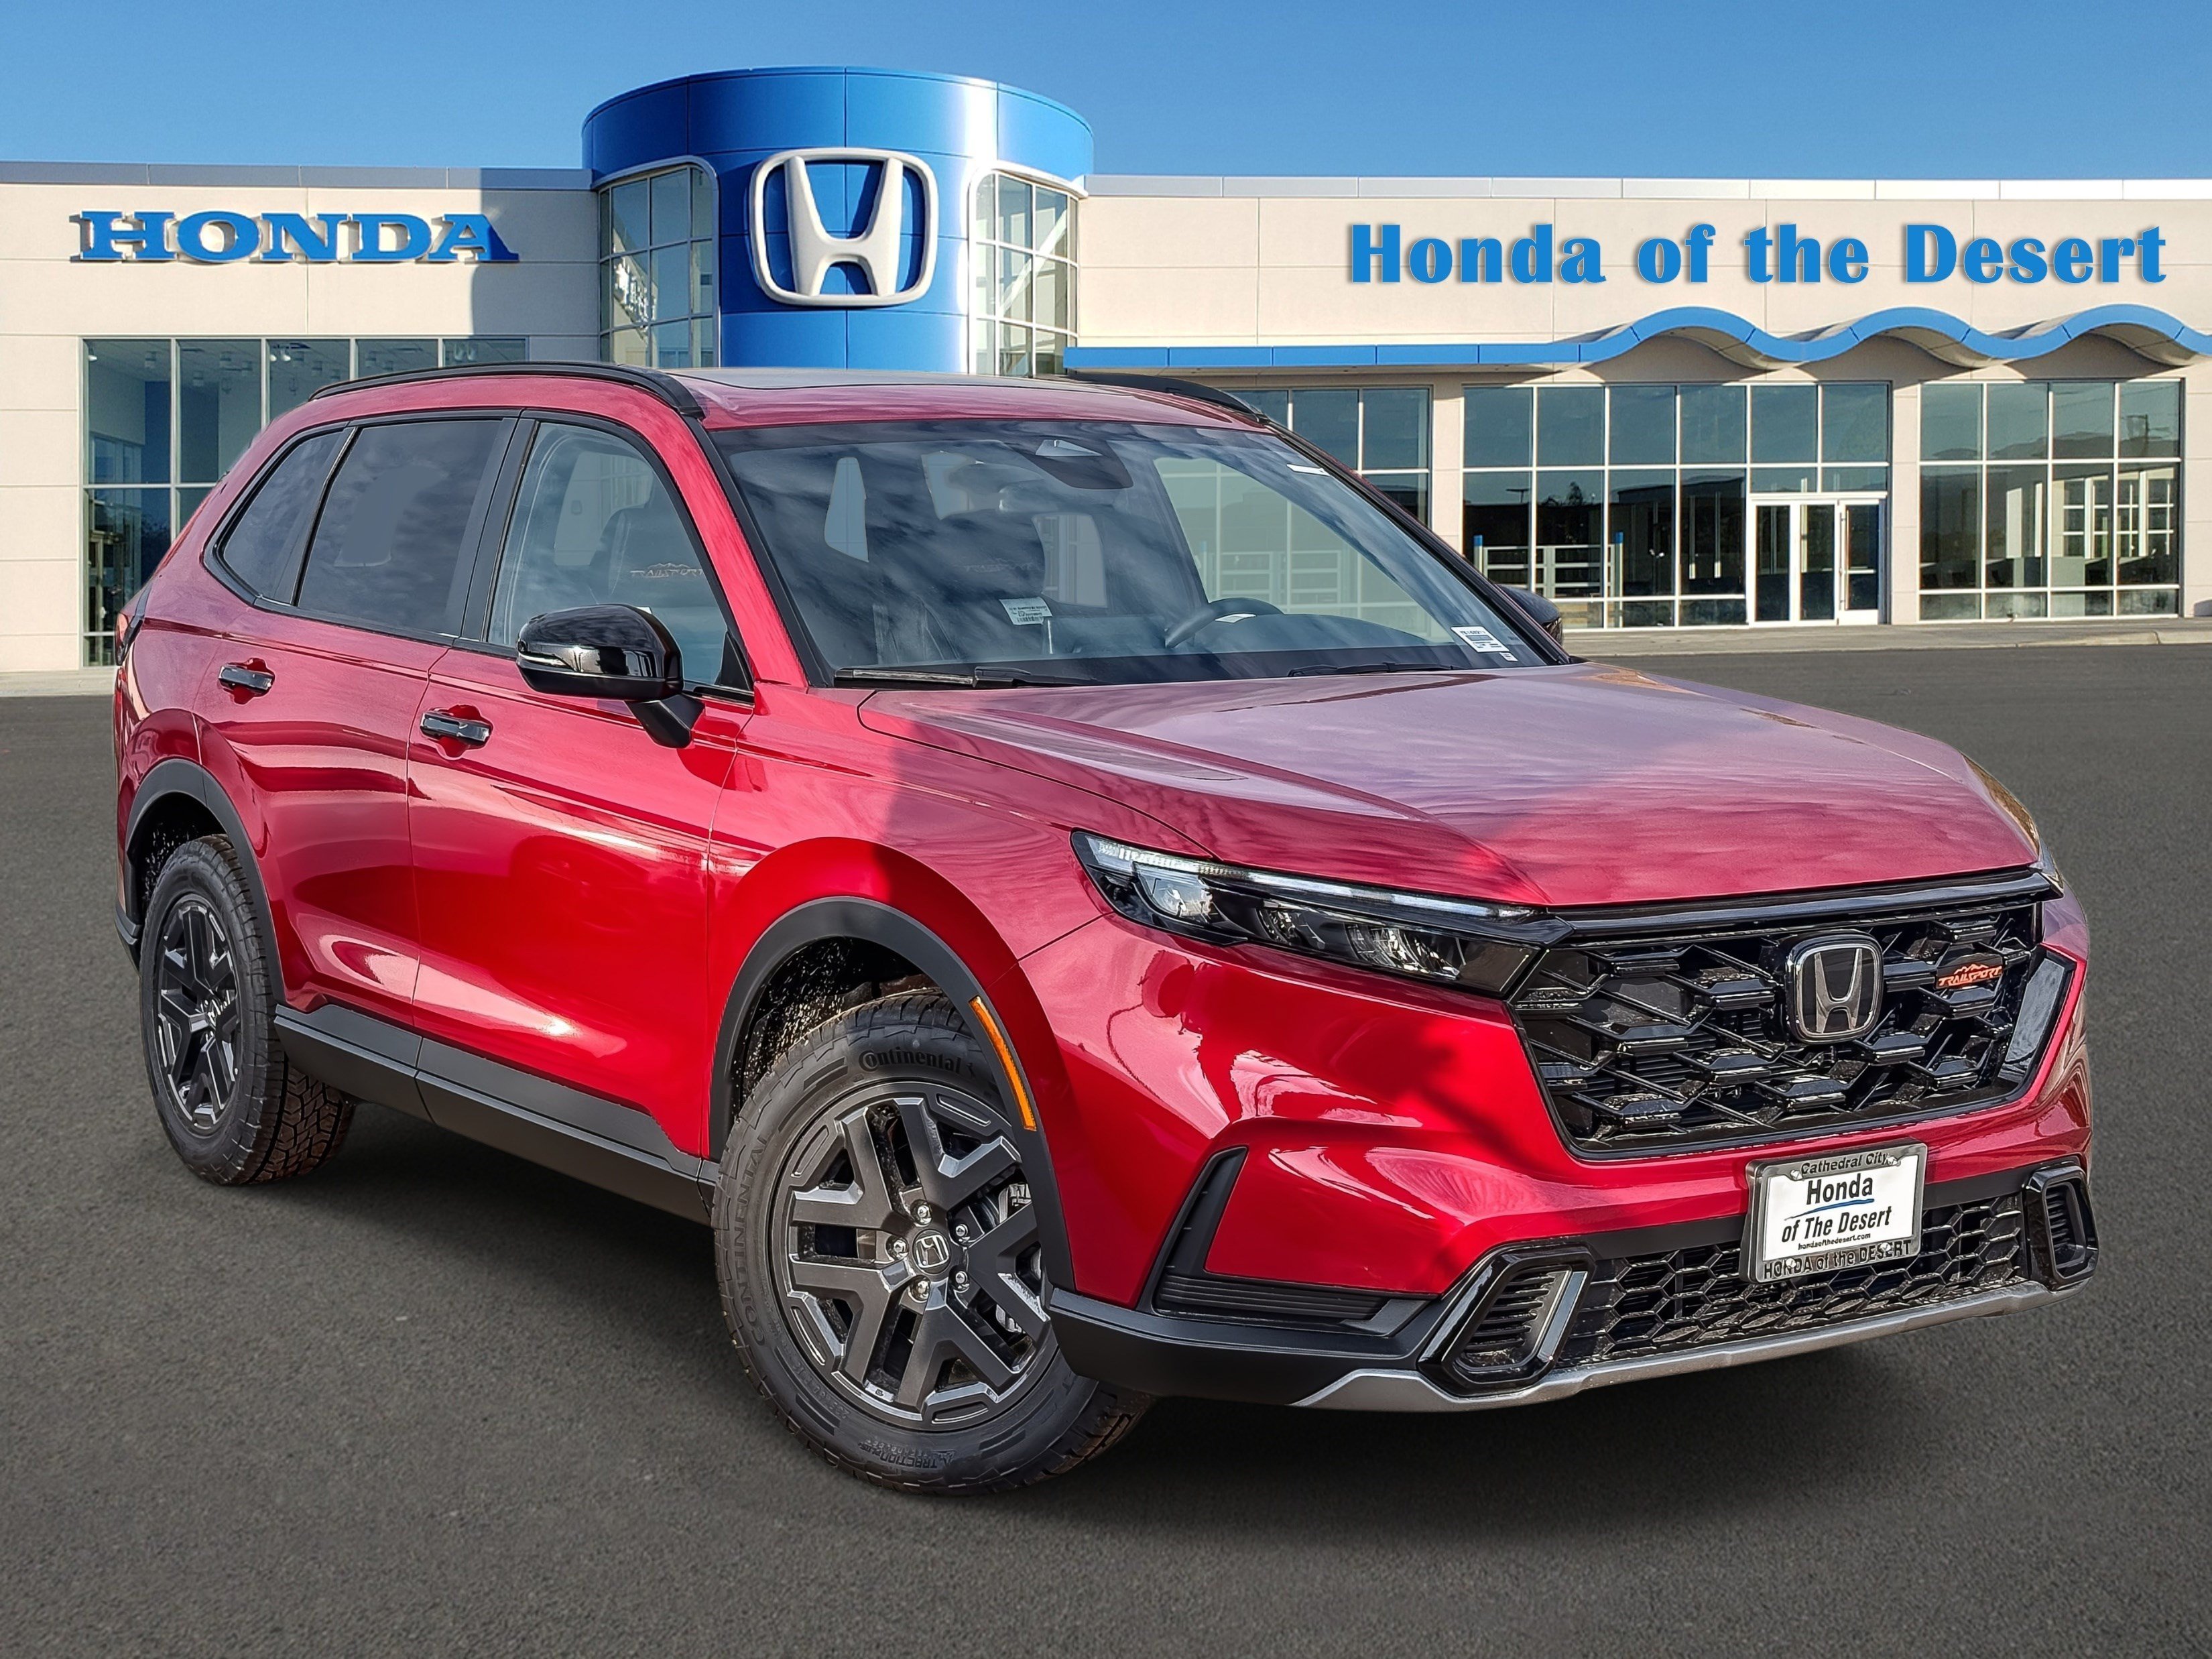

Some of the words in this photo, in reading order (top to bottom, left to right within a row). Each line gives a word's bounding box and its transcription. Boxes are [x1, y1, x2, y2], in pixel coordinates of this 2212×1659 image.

[79, 210, 519, 262] HONDA
[1351, 223, 1607, 284] Honda
[1638, 223, 1717, 284] of
[1743, 223, 1869, 284] the
[1906, 224, 2167, 284] Desert
[1939, 965, 2002, 986] TRAILSPORT
[858, 1046, 962, 1074] Continental
[1801, 1154, 1863, 1174] Cathedral
[1866, 1152, 1888, 1165] City
[1806, 1173, 1873, 1205] Honda
[1782, 1219, 1800, 1243] of
[1804, 1216, 1833, 1239] The
[1837, 1206, 1892, 1233] Desert
[1816, 1253, 1829, 1271] of
[1833, 1248, 1854, 1266] the
